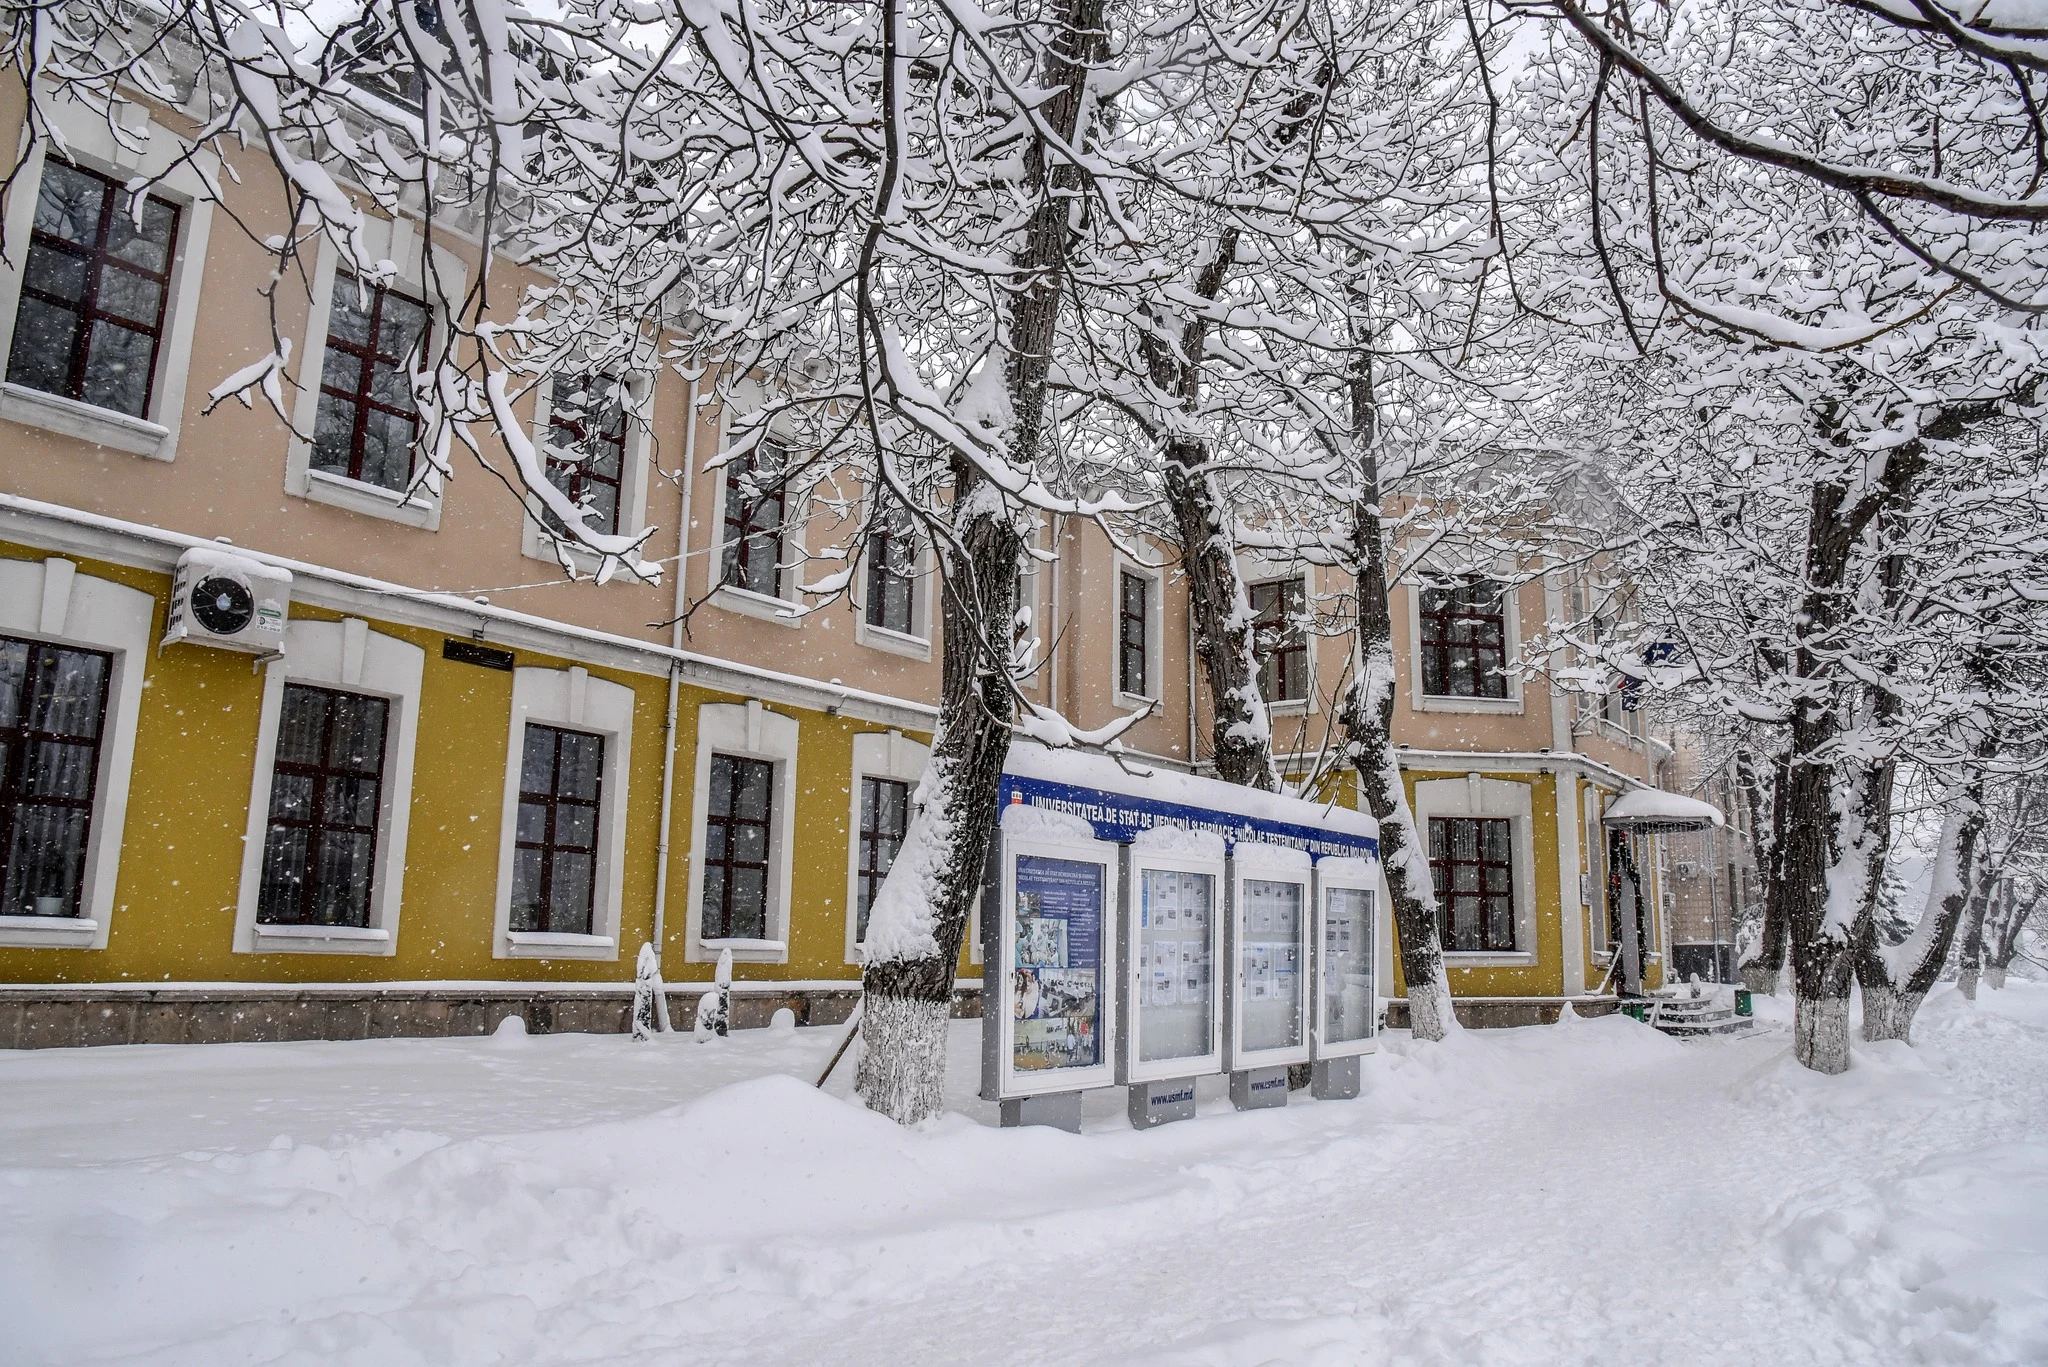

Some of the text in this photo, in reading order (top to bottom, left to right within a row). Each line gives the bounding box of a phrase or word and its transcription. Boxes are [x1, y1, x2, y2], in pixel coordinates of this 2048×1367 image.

[1031, 796, 1104, 822] UNIVERSITATEA
[1106, 807, 1117, 824] DE
[1119, 809, 1139, 827] STAT
[1141, 812, 1152, 829] DE
[1310, 839, 1321, 854] DIN
[1321, 841, 1349, 858] REPUBLICA
[1150, 1089, 1193, 1106] www.usmf.md
